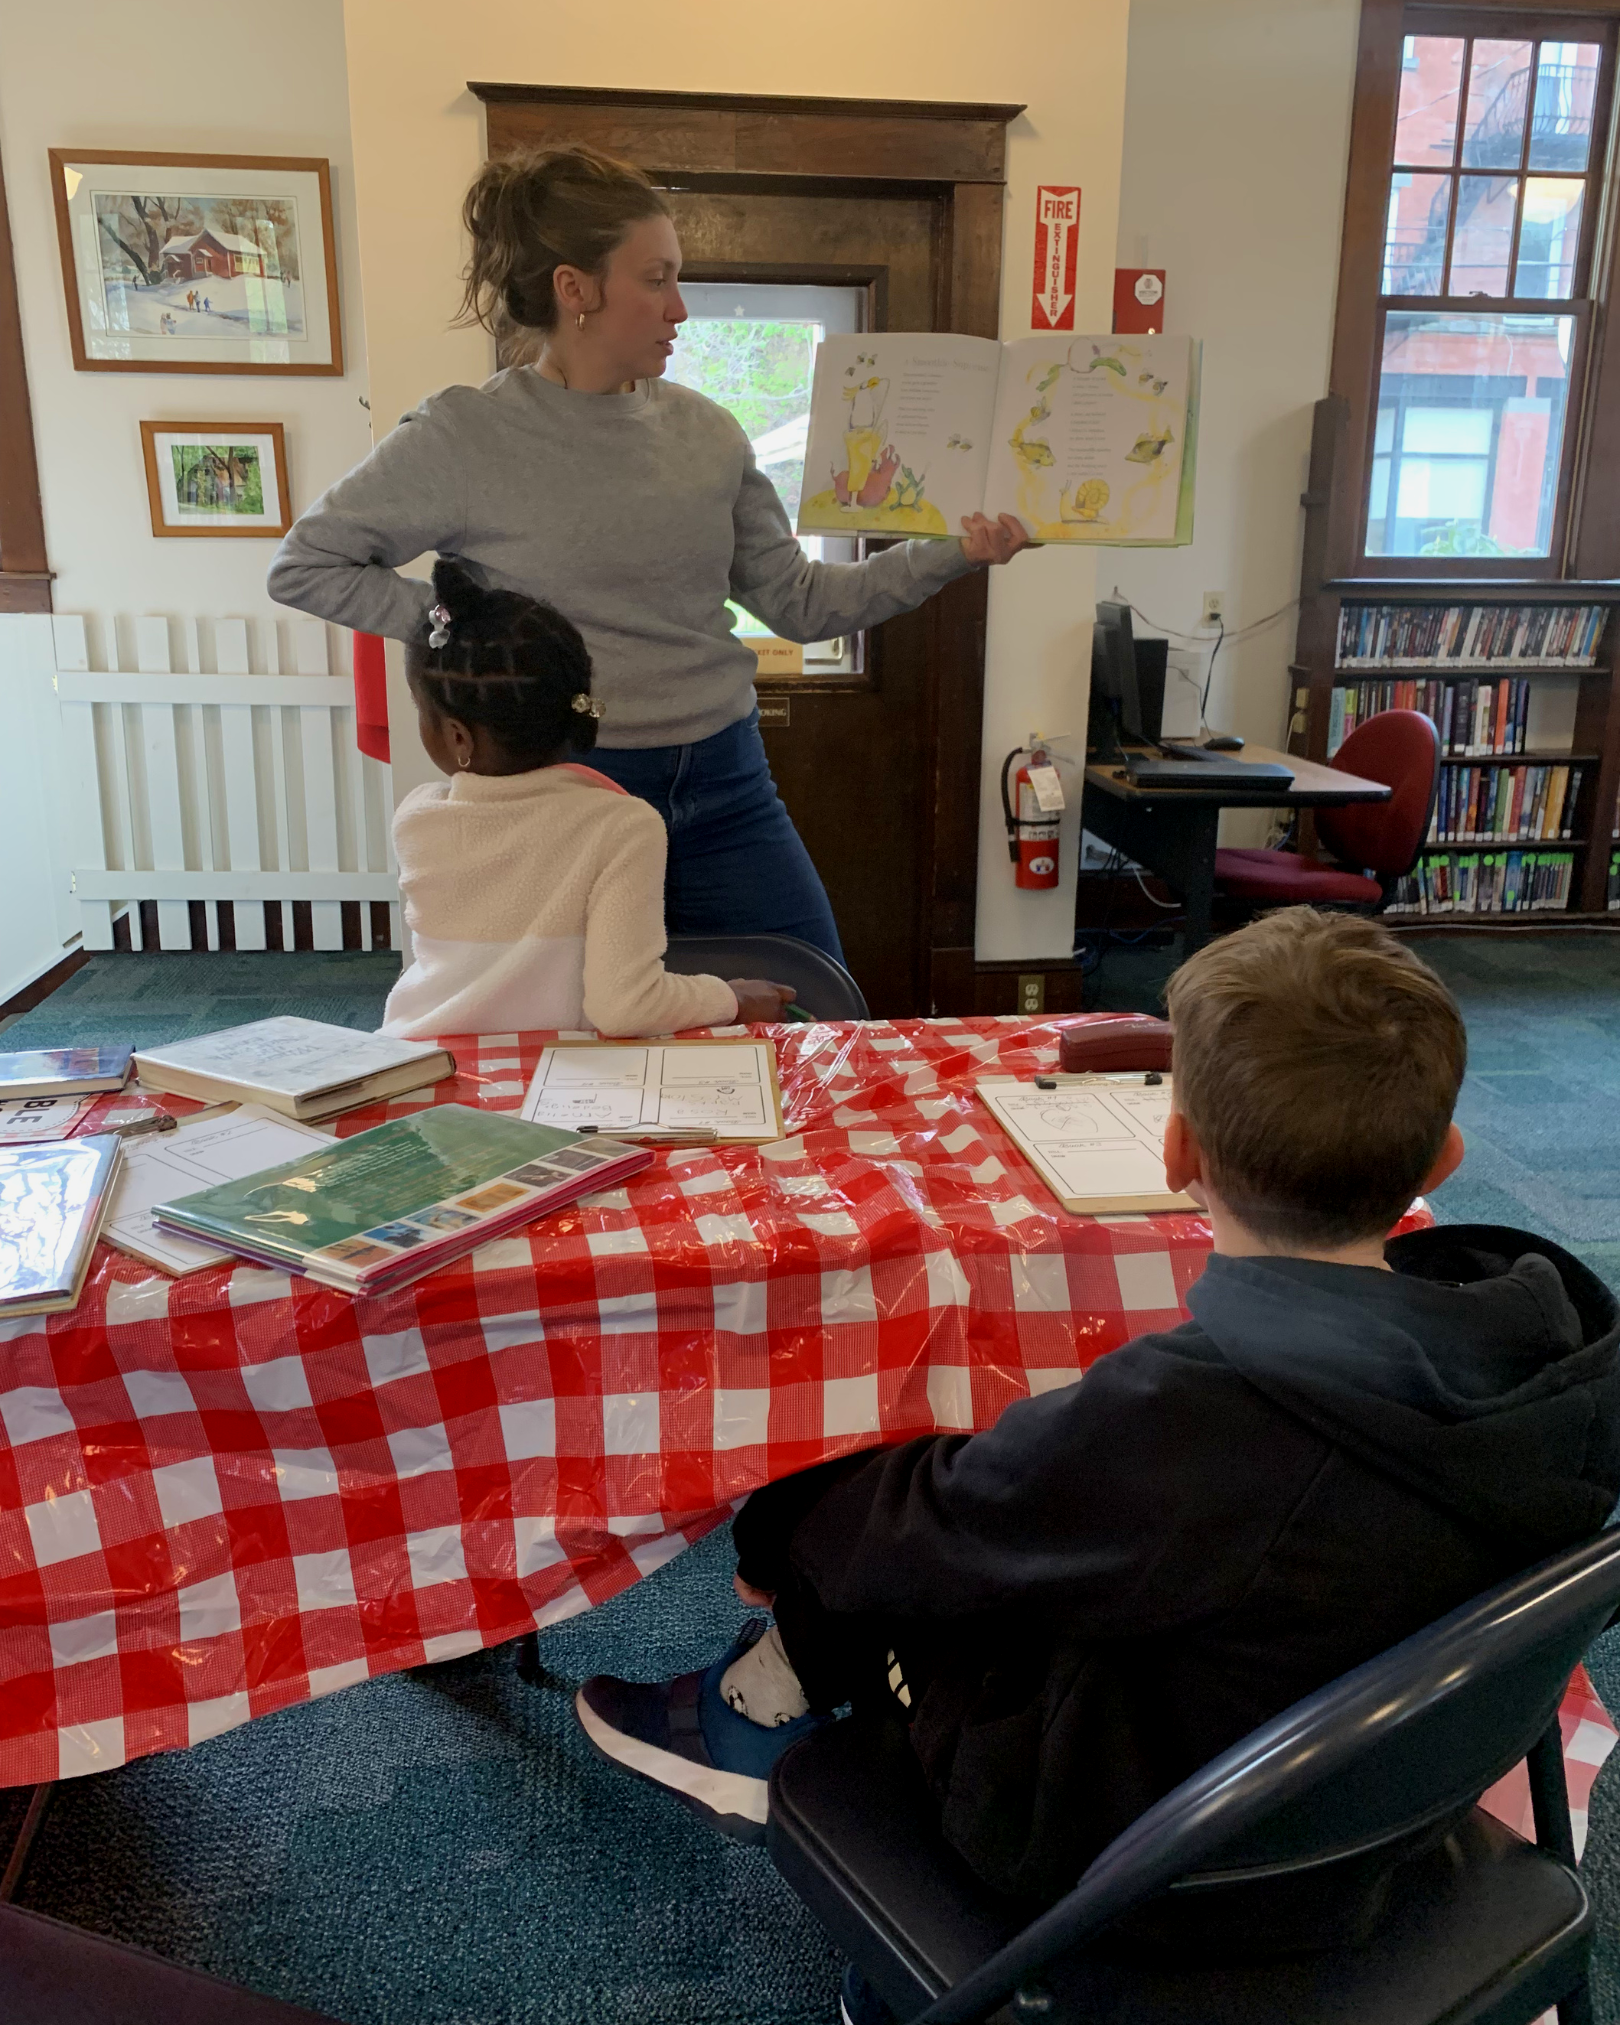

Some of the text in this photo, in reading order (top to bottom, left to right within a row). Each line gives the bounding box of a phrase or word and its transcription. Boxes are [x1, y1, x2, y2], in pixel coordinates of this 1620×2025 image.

[1044, 200, 1073, 219] FIRE
[1050, 223, 1061, 317] EXTINGUISHER
[758, 708, 787, 717] OKING
[6, 1099, 58, 1125] BLE
